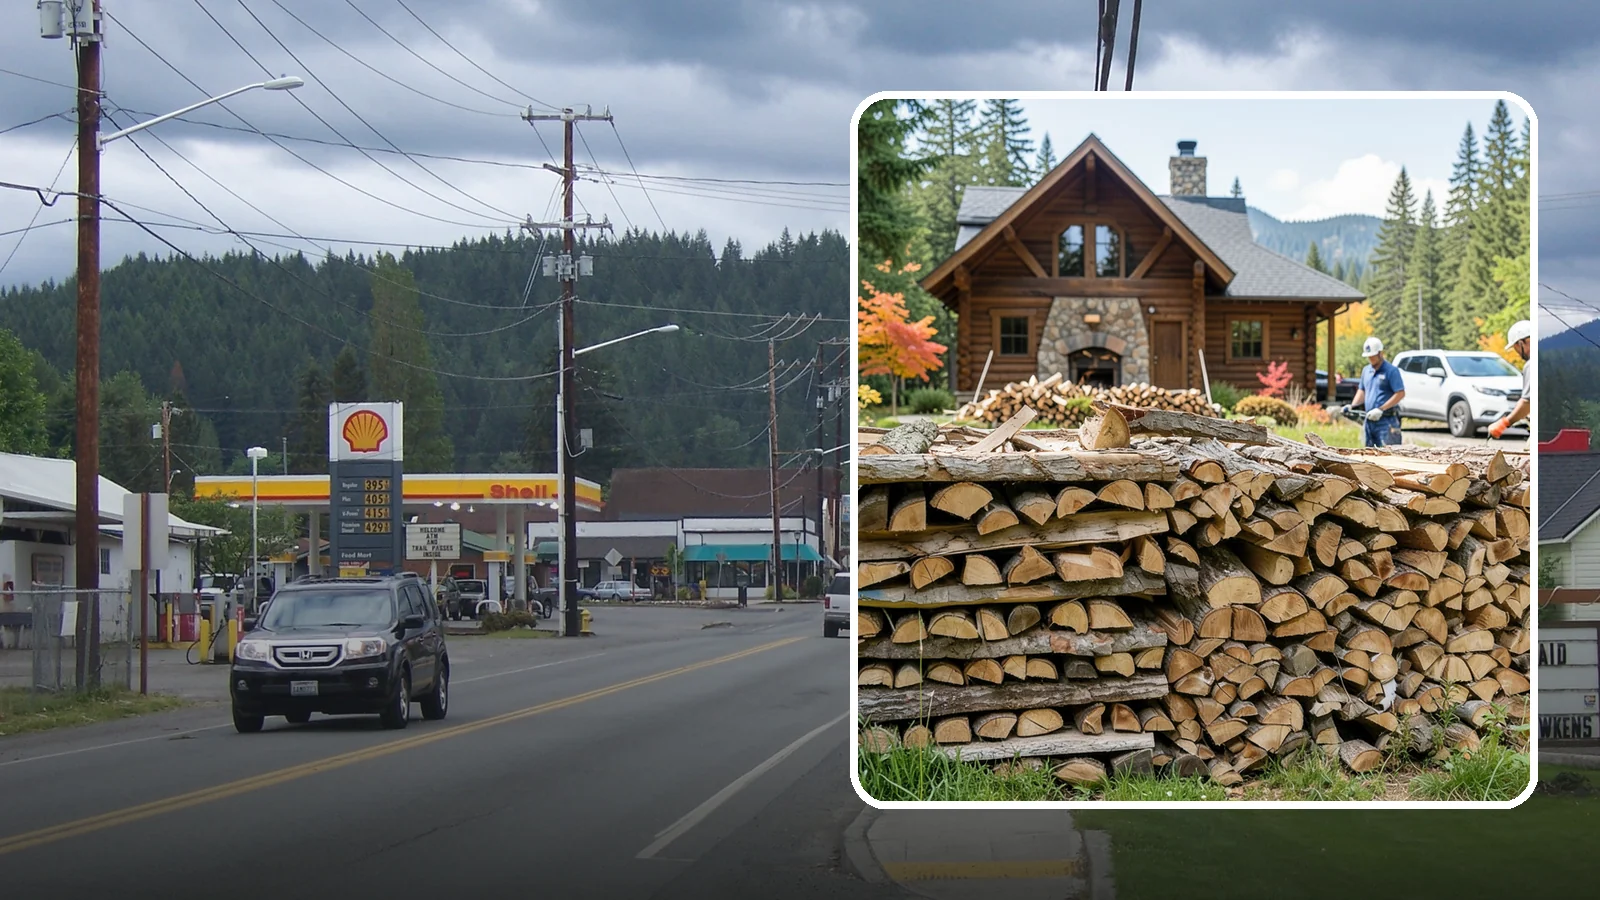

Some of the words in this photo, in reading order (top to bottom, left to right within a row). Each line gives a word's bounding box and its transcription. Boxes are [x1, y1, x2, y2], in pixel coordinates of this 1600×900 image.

[366, 480, 384, 490] 395
[490, 484, 547, 499] Shell
[366, 494, 384, 504] 405
[366, 508, 384, 518] 415
[366, 522, 384, 532] 429
